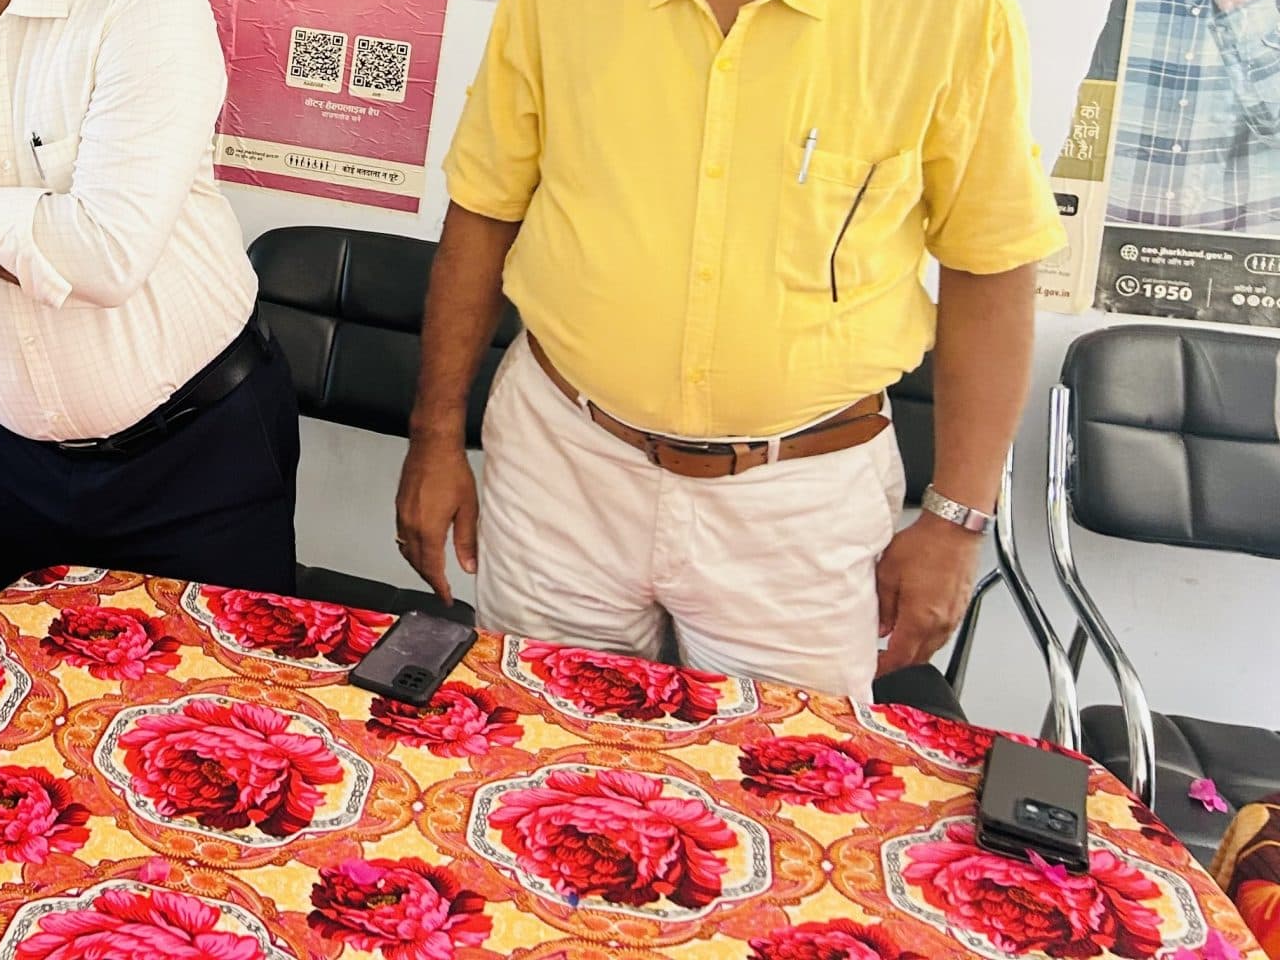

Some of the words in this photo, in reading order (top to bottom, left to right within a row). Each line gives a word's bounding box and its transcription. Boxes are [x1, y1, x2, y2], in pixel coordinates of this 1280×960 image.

[1080, 101, 1100, 119] को
[1073, 120, 1100, 140] होने
[1142, 283, 1193, 302] 1950
